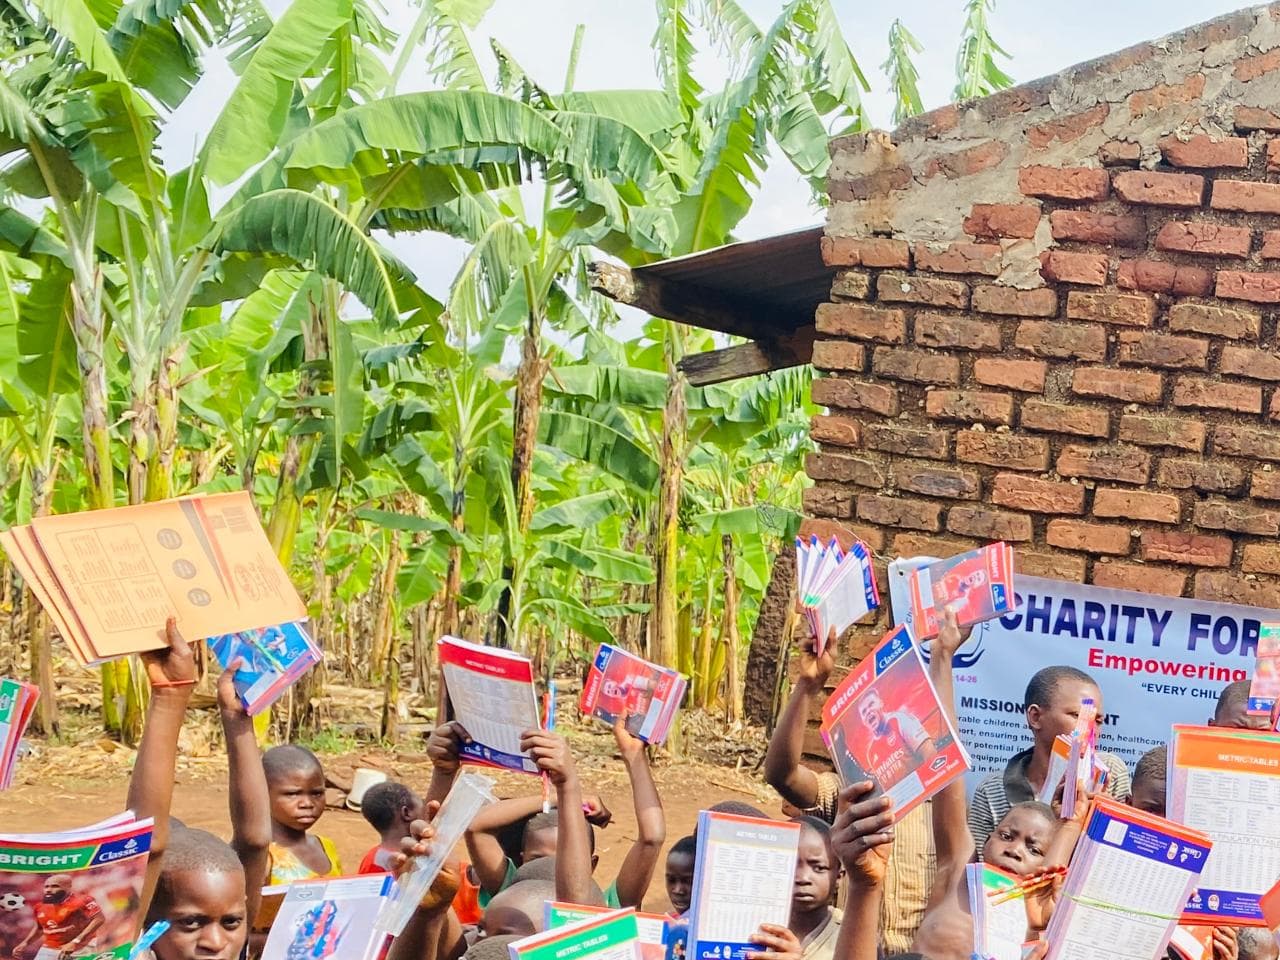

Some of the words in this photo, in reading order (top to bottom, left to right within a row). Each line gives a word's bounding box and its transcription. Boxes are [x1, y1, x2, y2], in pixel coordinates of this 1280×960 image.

[1000, 593, 1173, 647] CHARITY
[1187, 612, 1260, 657] FOR
[878, 643, 905, 670] Classic
[1088, 648, 1247, 682] Empowering
[830, 670, 871, 717] BRIGHT
[1191, 688, 1221, 700] CHIL
[961, 696, 1025, 714] MISSION
[983, 718, 1020, 729] children
[979, 730, 1018, 742] ensuring
[974, 741, 1014, 752] potential
[1218, 753, 1247, 764] METRIC
[1249, 755, 1279, 767] TABLES
[0, 851, 82, 867] BRIGHT
[99, 845, 139, 862] Classic
